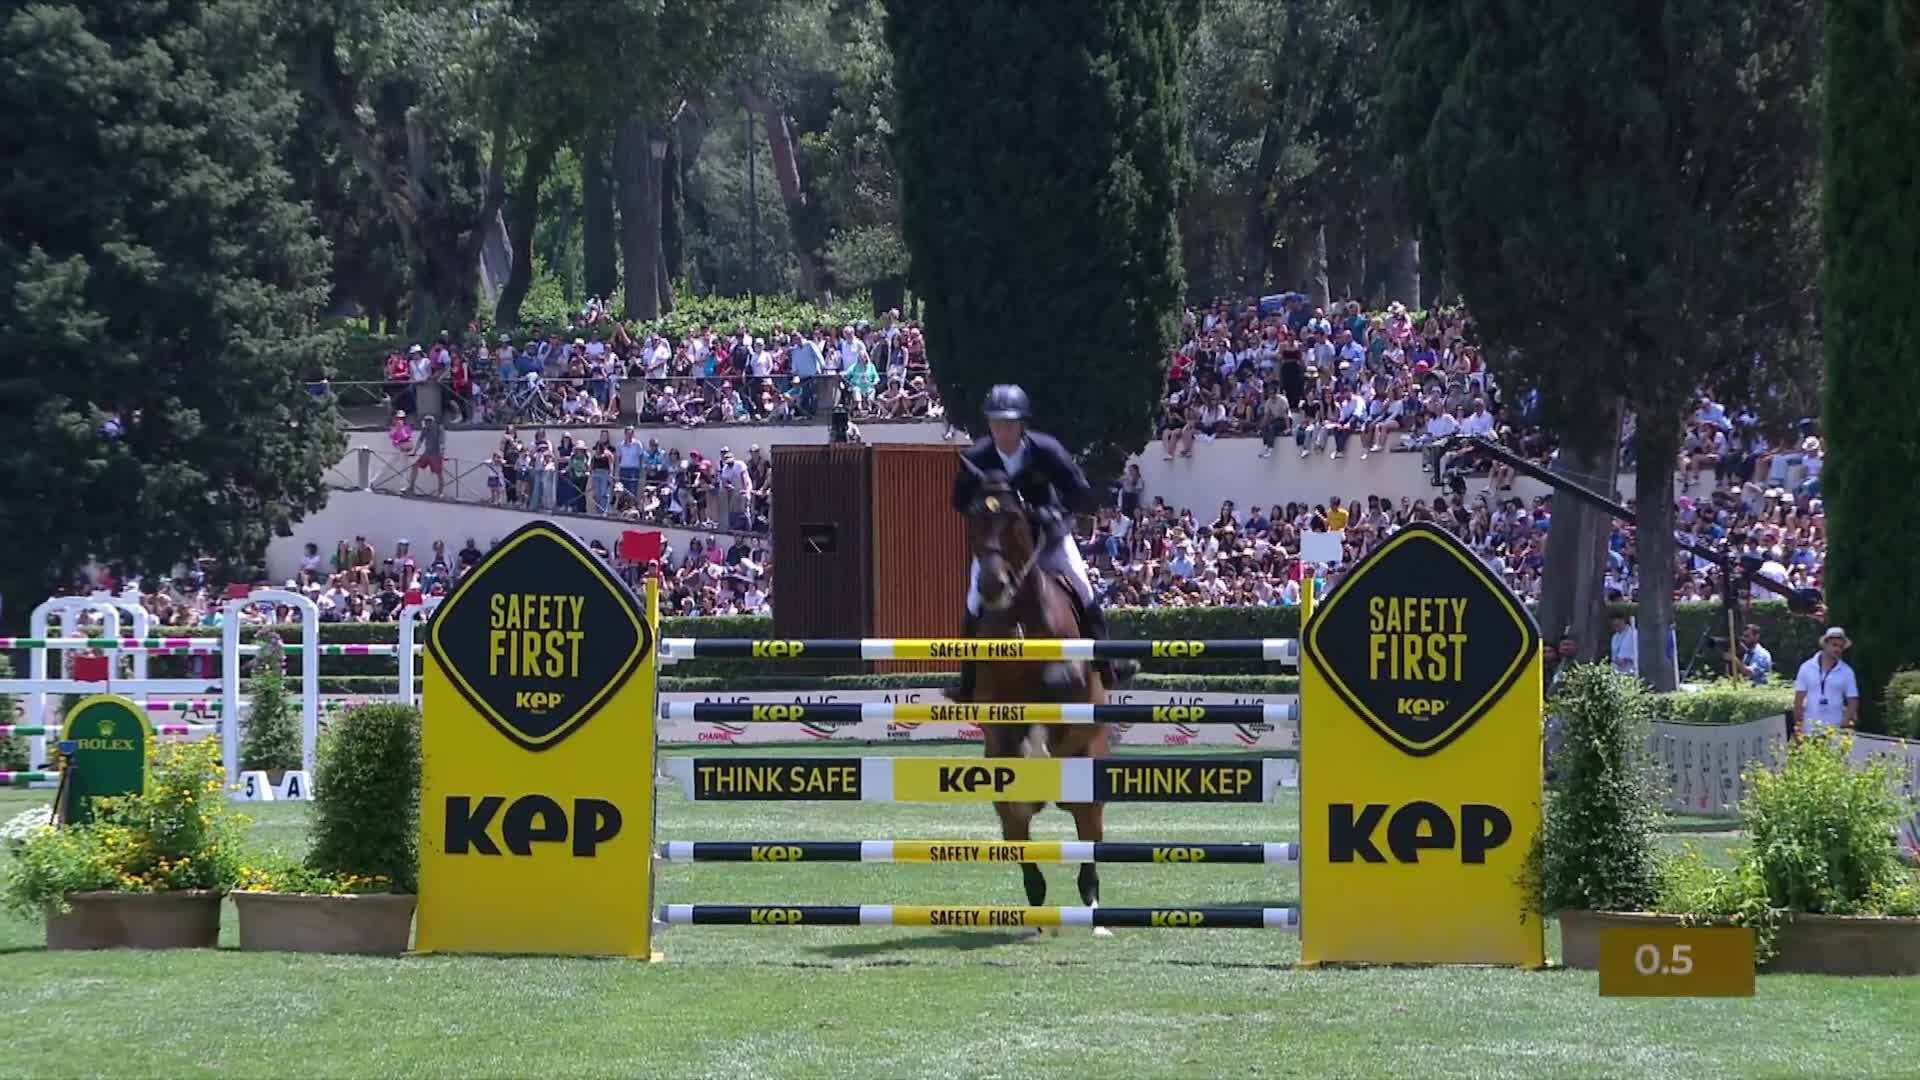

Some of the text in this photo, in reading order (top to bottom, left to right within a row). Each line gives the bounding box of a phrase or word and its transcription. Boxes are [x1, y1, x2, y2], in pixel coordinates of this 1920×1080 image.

[490, 593, 585, 630] SAFETY
[1369, 596, 1468, 633] SAFETY
[489, 631, 585, 678] FIRST
[930, 641, 1025, 658] SAFETY FIRST
[1369, 634, 1468, 682] FIRST
[930, 705, 1026, 721] SAFETY FIRST
[78, 738, 134, 751] ROLEX
[245, 776, 255, 798] 5
[287, 776, 301, 798] A
[698, 766, 857, 793] THINK SAFE
[1106, 767, 1252, 794] THINK KEP
[930, 846, 1026, 861] SAFETY FIRST
[930, 910, 1026, 926] SAFETY FIRST
